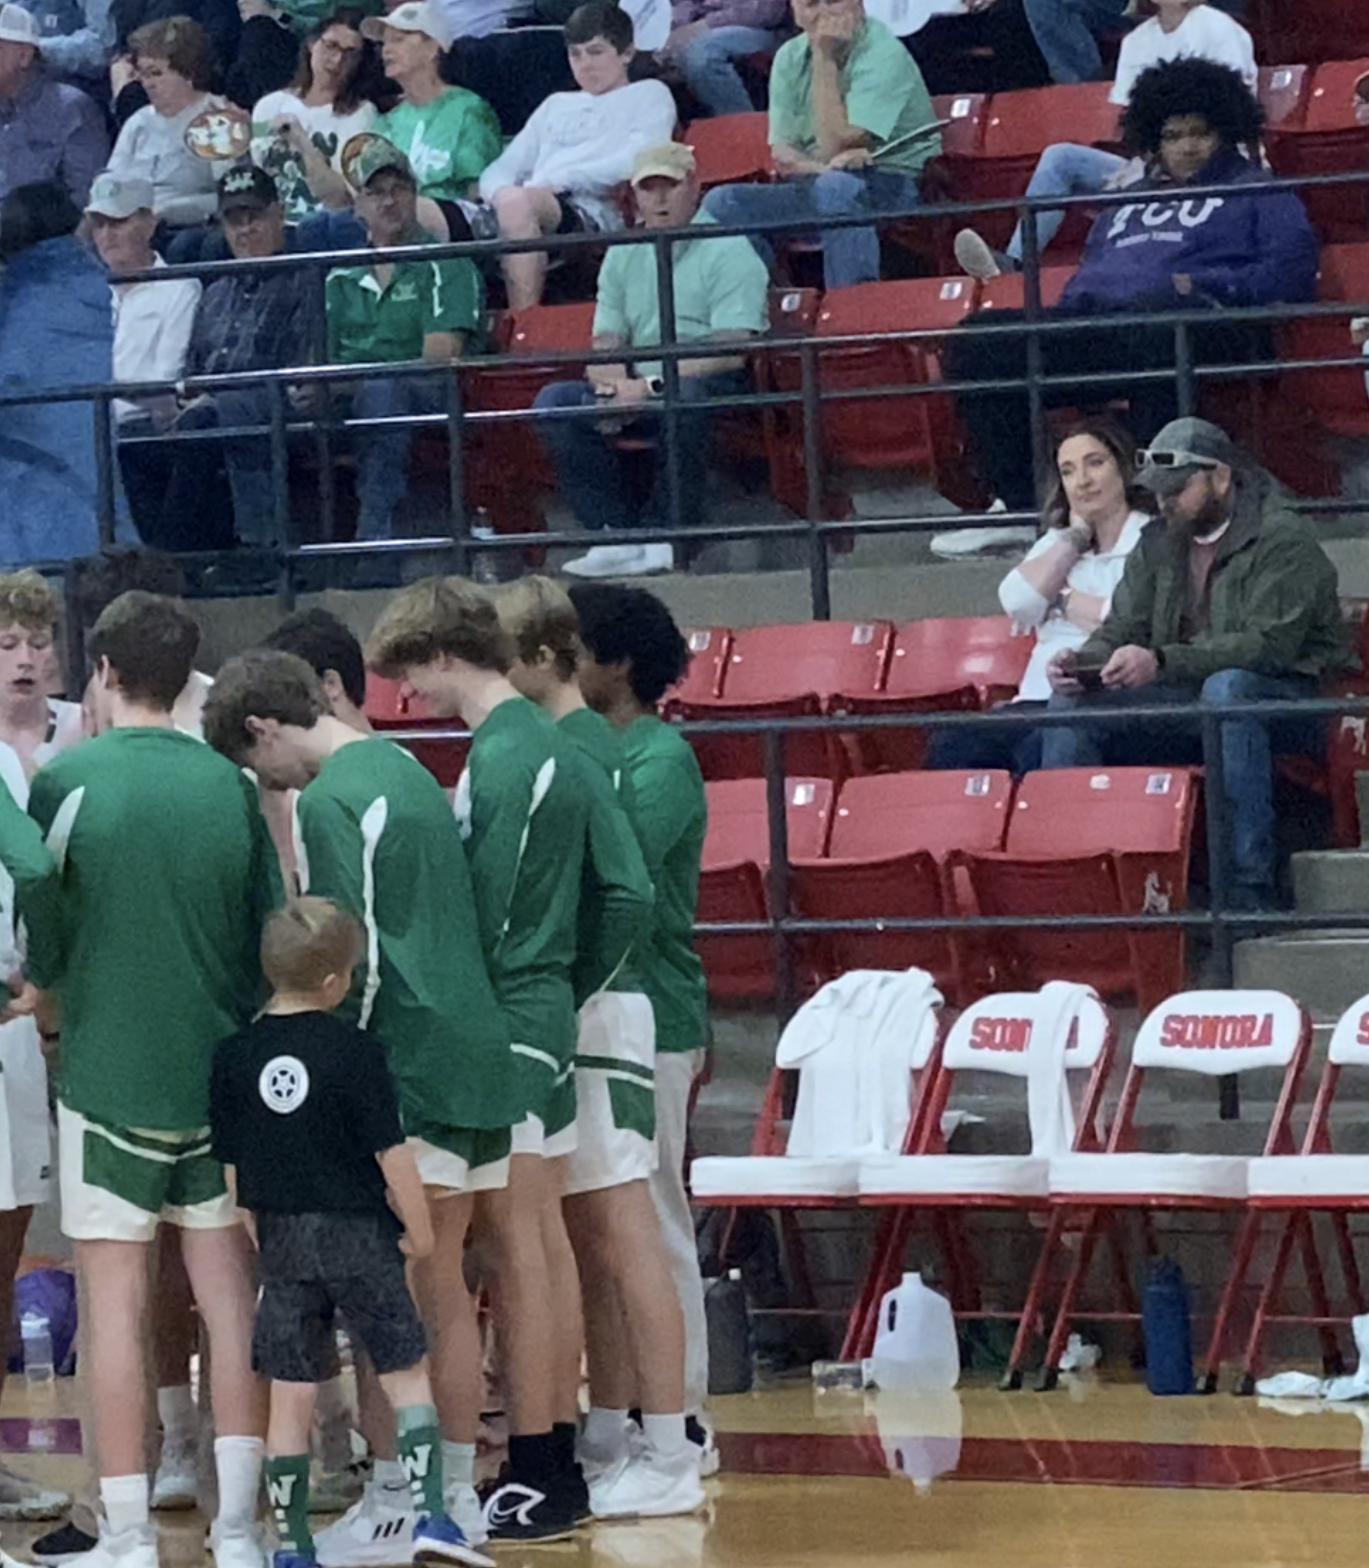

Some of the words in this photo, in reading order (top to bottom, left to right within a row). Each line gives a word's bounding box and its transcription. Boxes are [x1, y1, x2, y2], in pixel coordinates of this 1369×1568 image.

[1107, 198, 1224, 239] TCU
[968, 1016, 1079, 1052] SONA
[1159, 1013, 1274, 1050] SONORA
